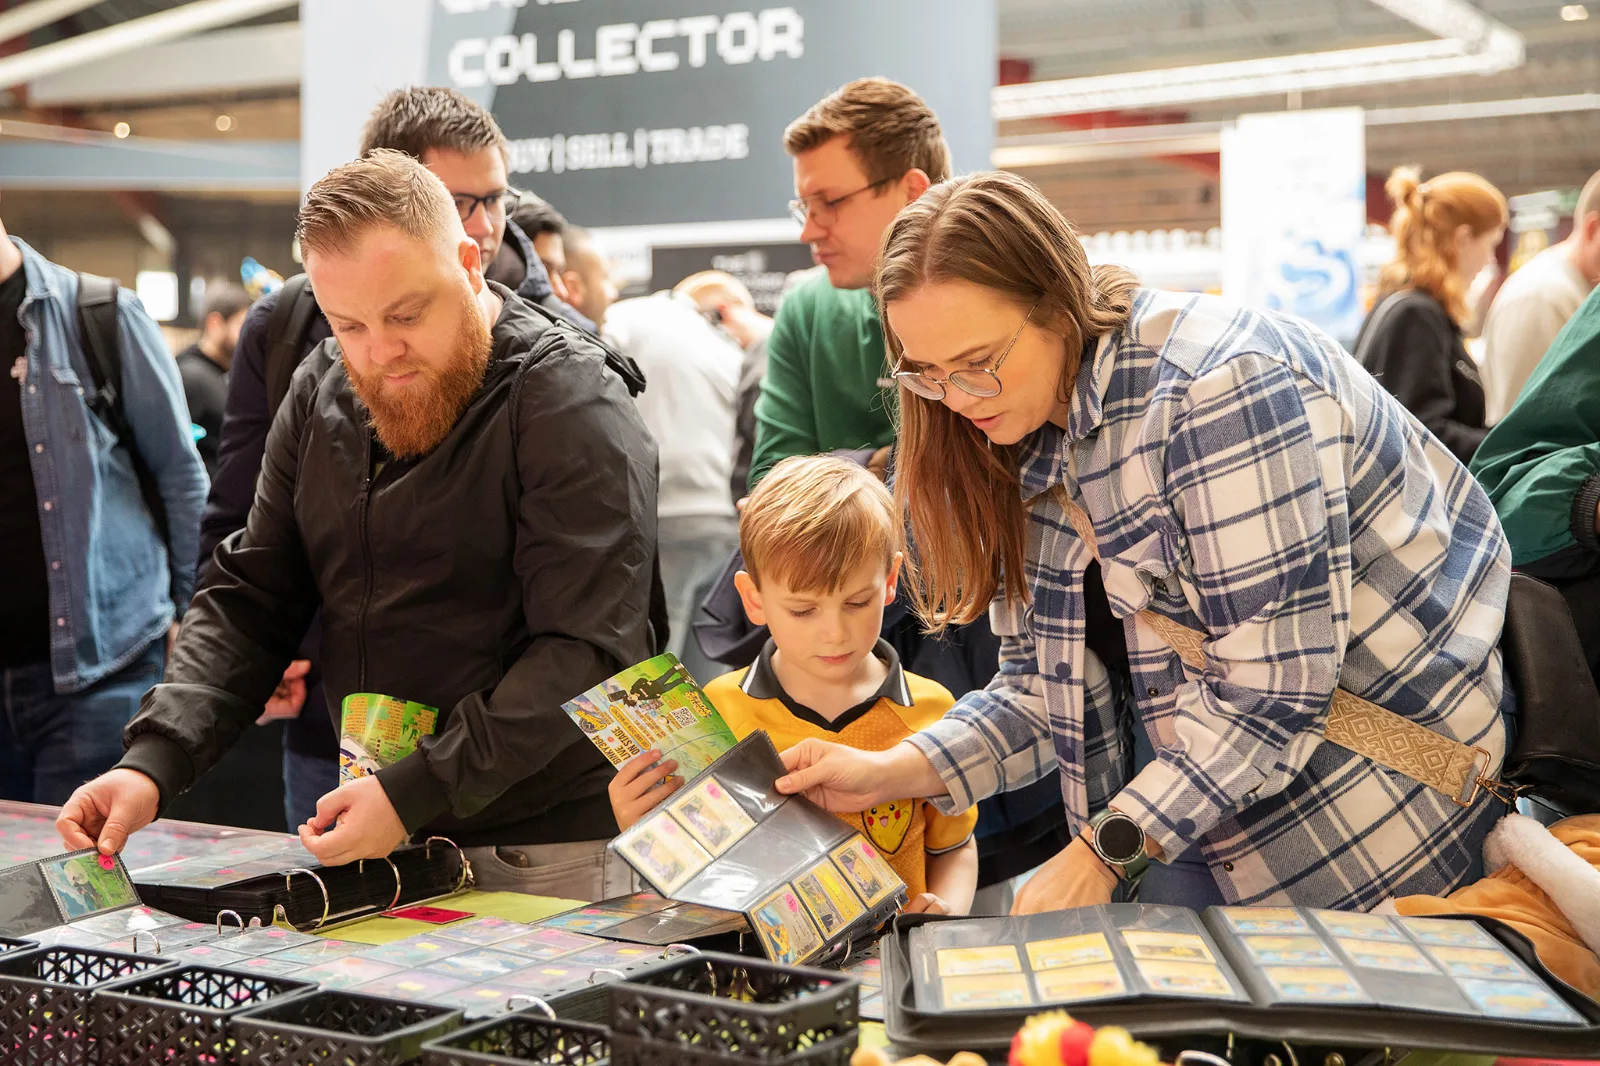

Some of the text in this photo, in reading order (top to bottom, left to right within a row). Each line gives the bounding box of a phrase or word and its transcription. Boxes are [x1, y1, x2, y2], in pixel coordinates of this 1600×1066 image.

[447, 7, 804, 88] COLLECTOR
[565, 132, 634, 170] SELL
[649, 123, 749, 165] TRADE
[592, 735, 622, 765] BINKY364
[611, 726, 640, 755] ON STAGE
[614, 746, 631, 760] LIVE
